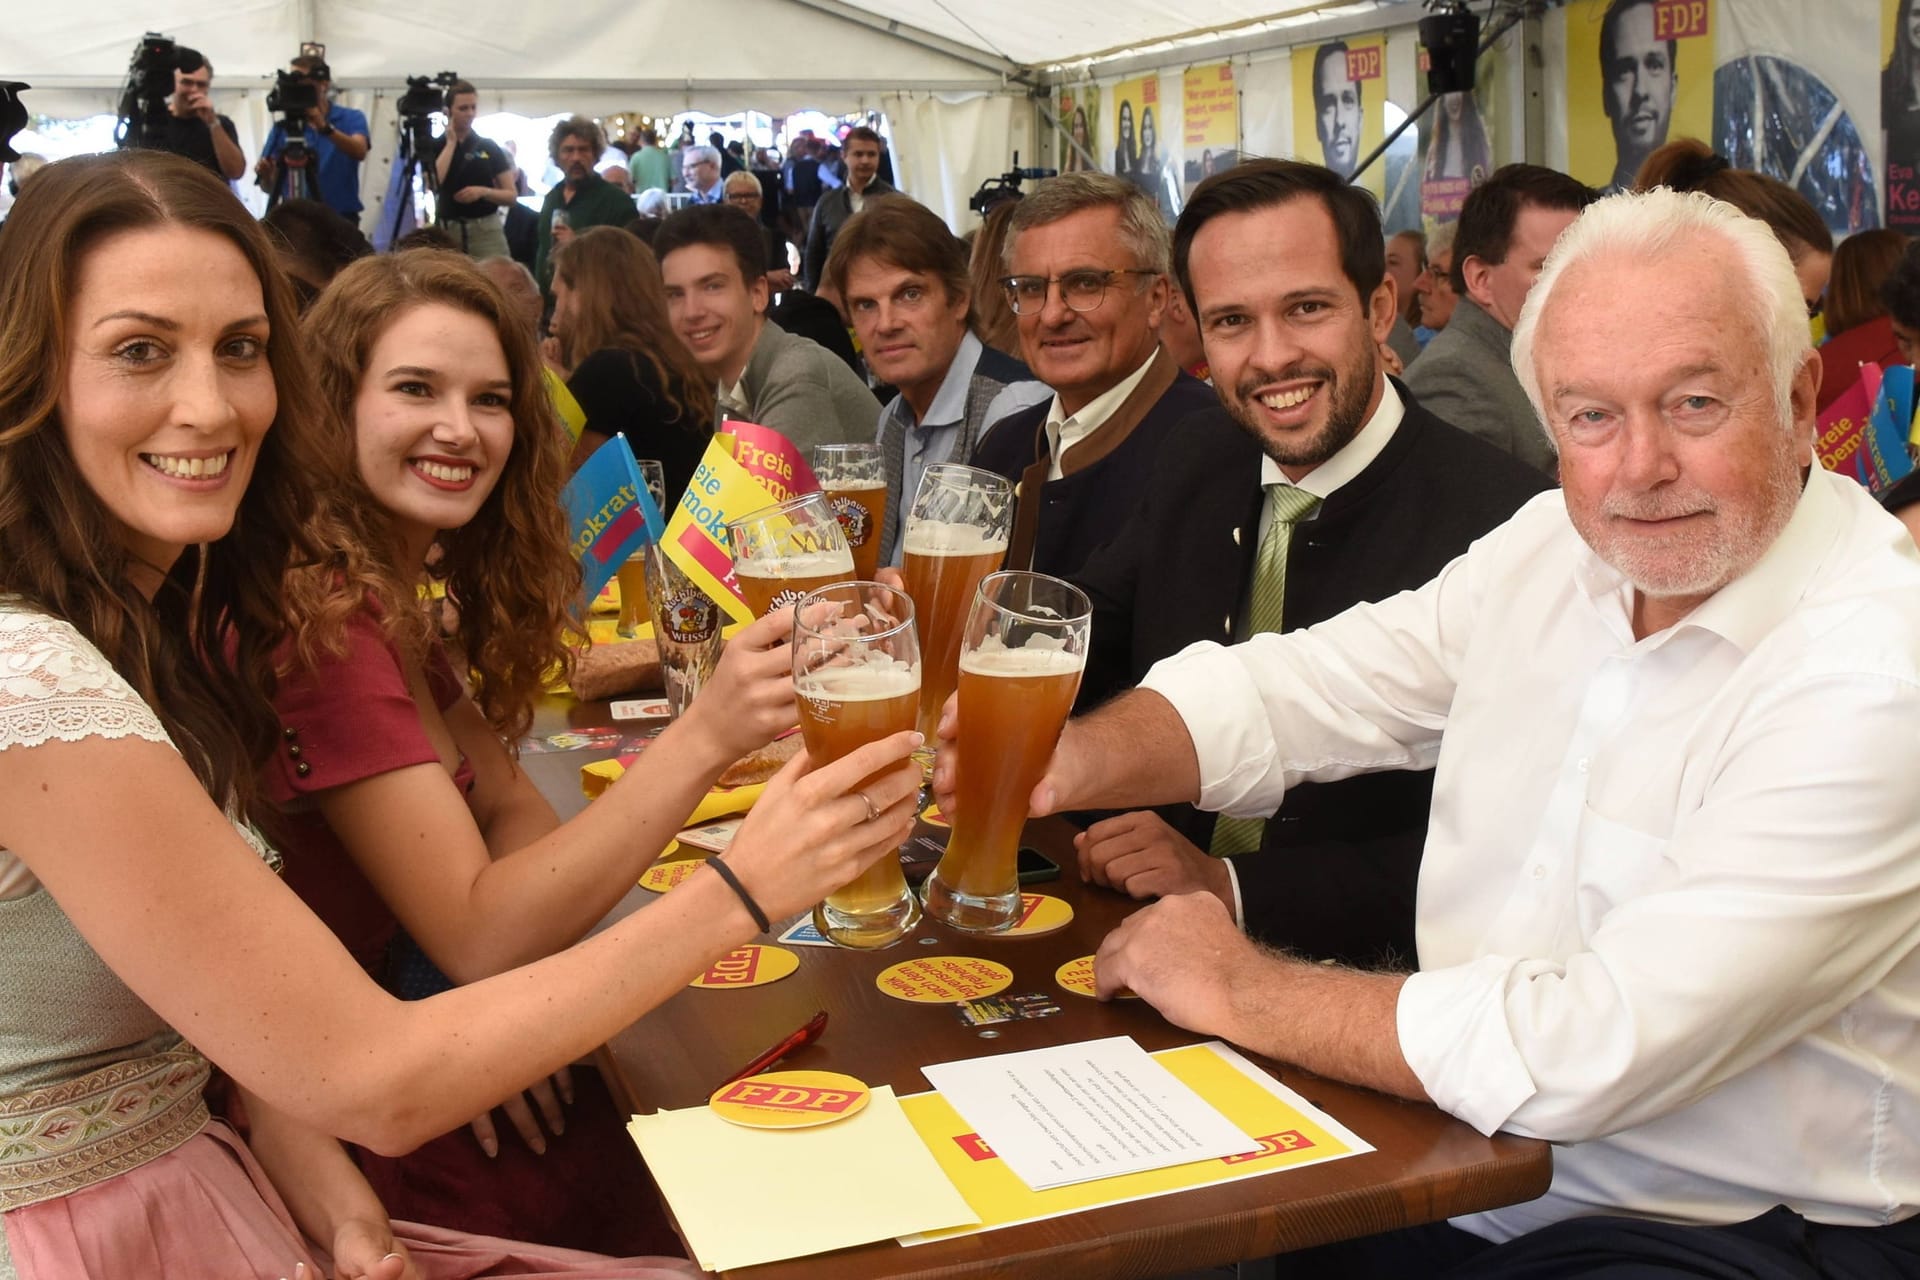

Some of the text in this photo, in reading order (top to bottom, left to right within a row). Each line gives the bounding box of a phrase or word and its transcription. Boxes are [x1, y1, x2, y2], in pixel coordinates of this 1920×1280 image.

[1657, 1, 1705, 35] FDP
[1347, 50, 1378, 77] FDP
[736, 440, 793, 481] Freie
[884, 976, 924, 998] Politik
[897, 966, 954, 998] nach dem
[912, 959, 979, 999] bayerischen
[729, 1084, 849, 1109] FDP
